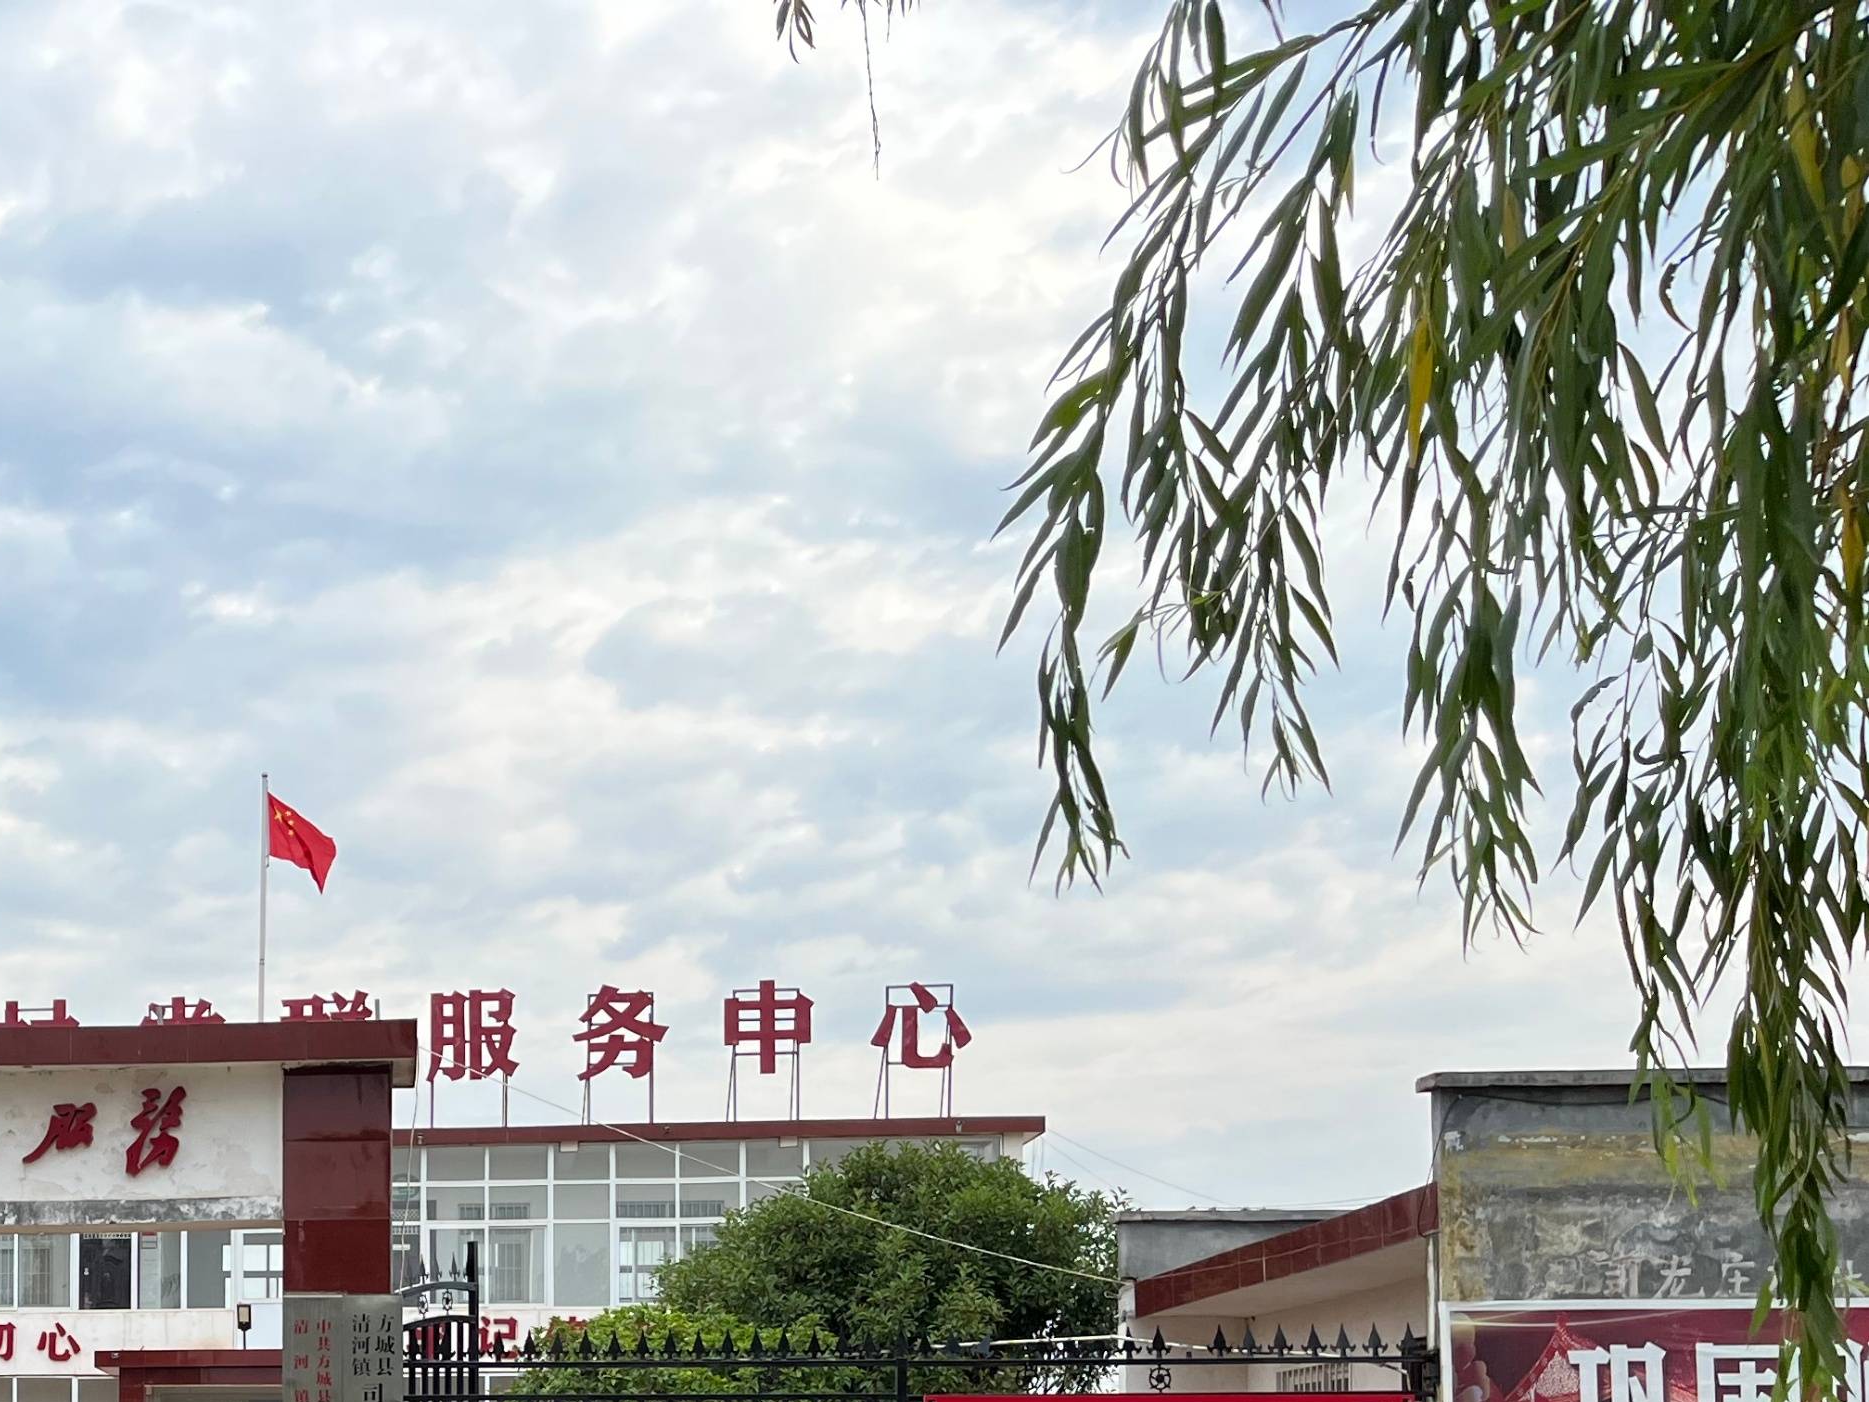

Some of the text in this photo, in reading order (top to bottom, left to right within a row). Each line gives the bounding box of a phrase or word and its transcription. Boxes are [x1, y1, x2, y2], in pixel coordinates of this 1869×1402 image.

[352, 1313, 371, 1377] 清河镇
[375, 1313, 395, 1377] 方城县
